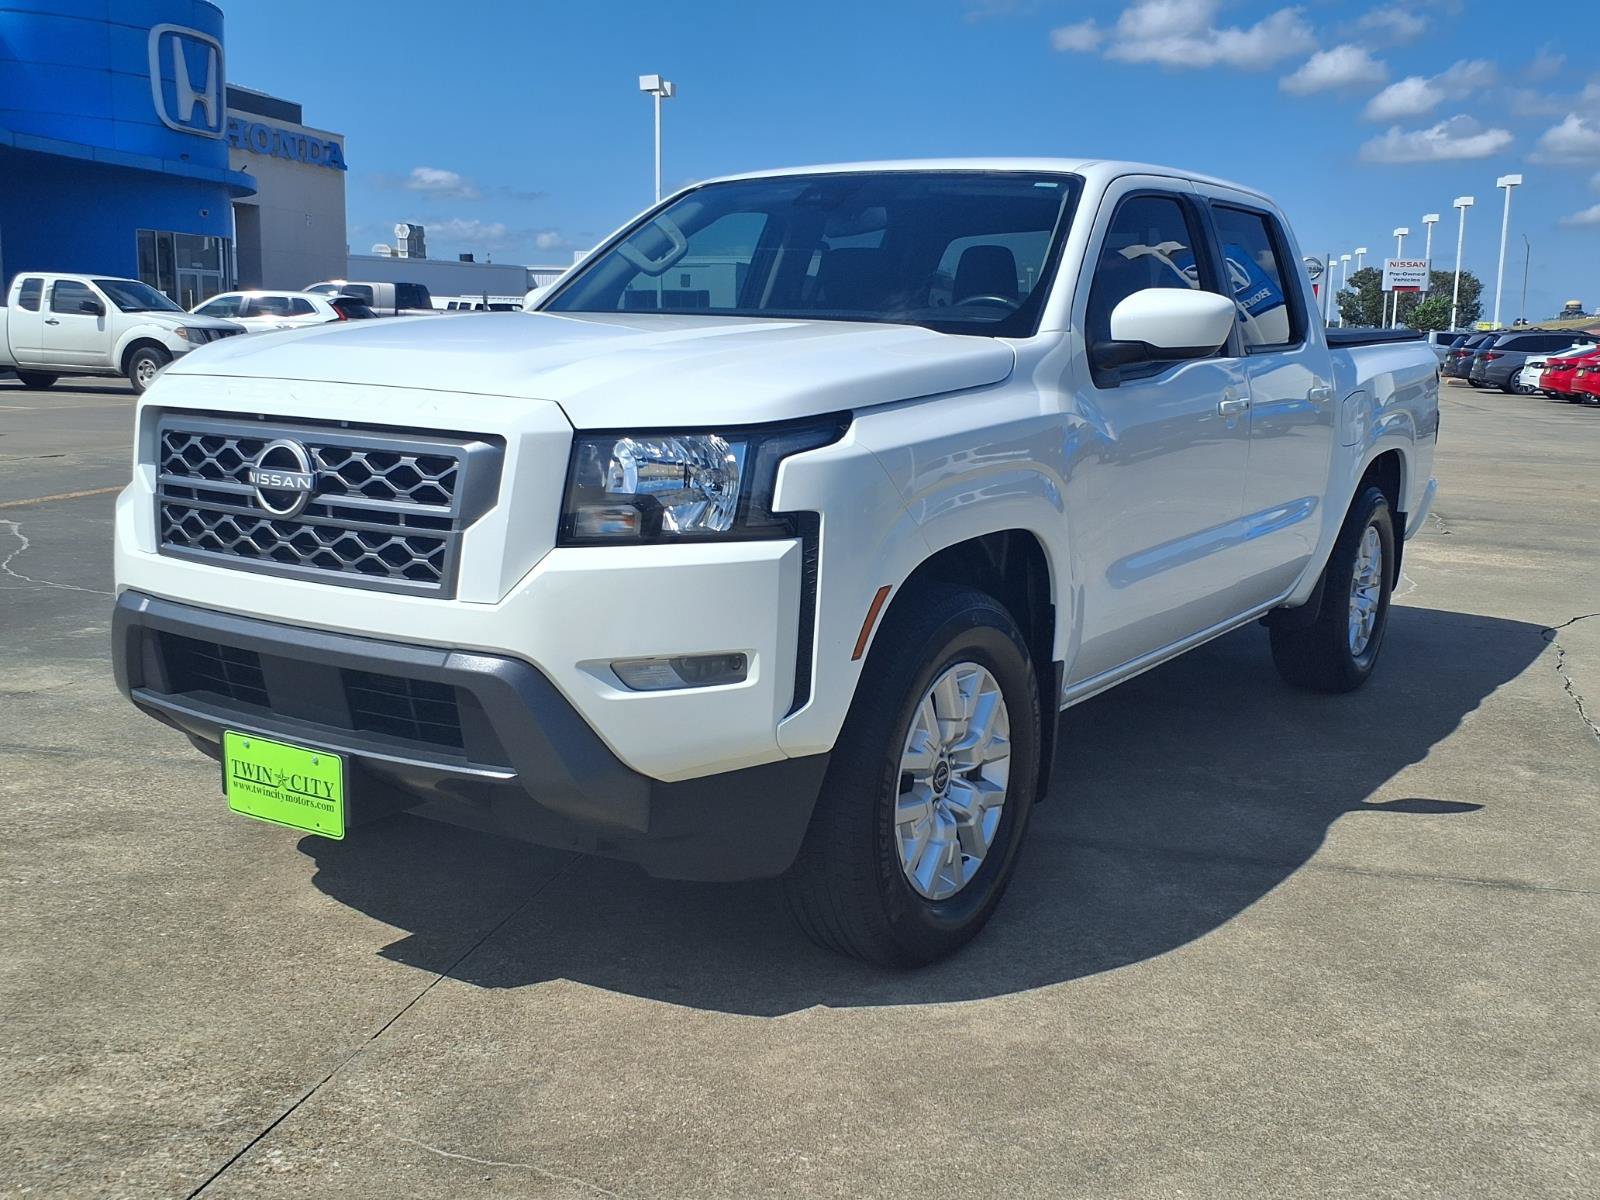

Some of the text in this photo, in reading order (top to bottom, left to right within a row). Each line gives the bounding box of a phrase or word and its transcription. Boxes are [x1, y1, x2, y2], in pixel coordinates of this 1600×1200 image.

[223, 116, 347, 171] HONDA
[248, 471, 311, 489] NISSAN
[231, 758, 335, 798] TWIN CITY
[233, 780, 335, 813] www.twincitymotors.com
